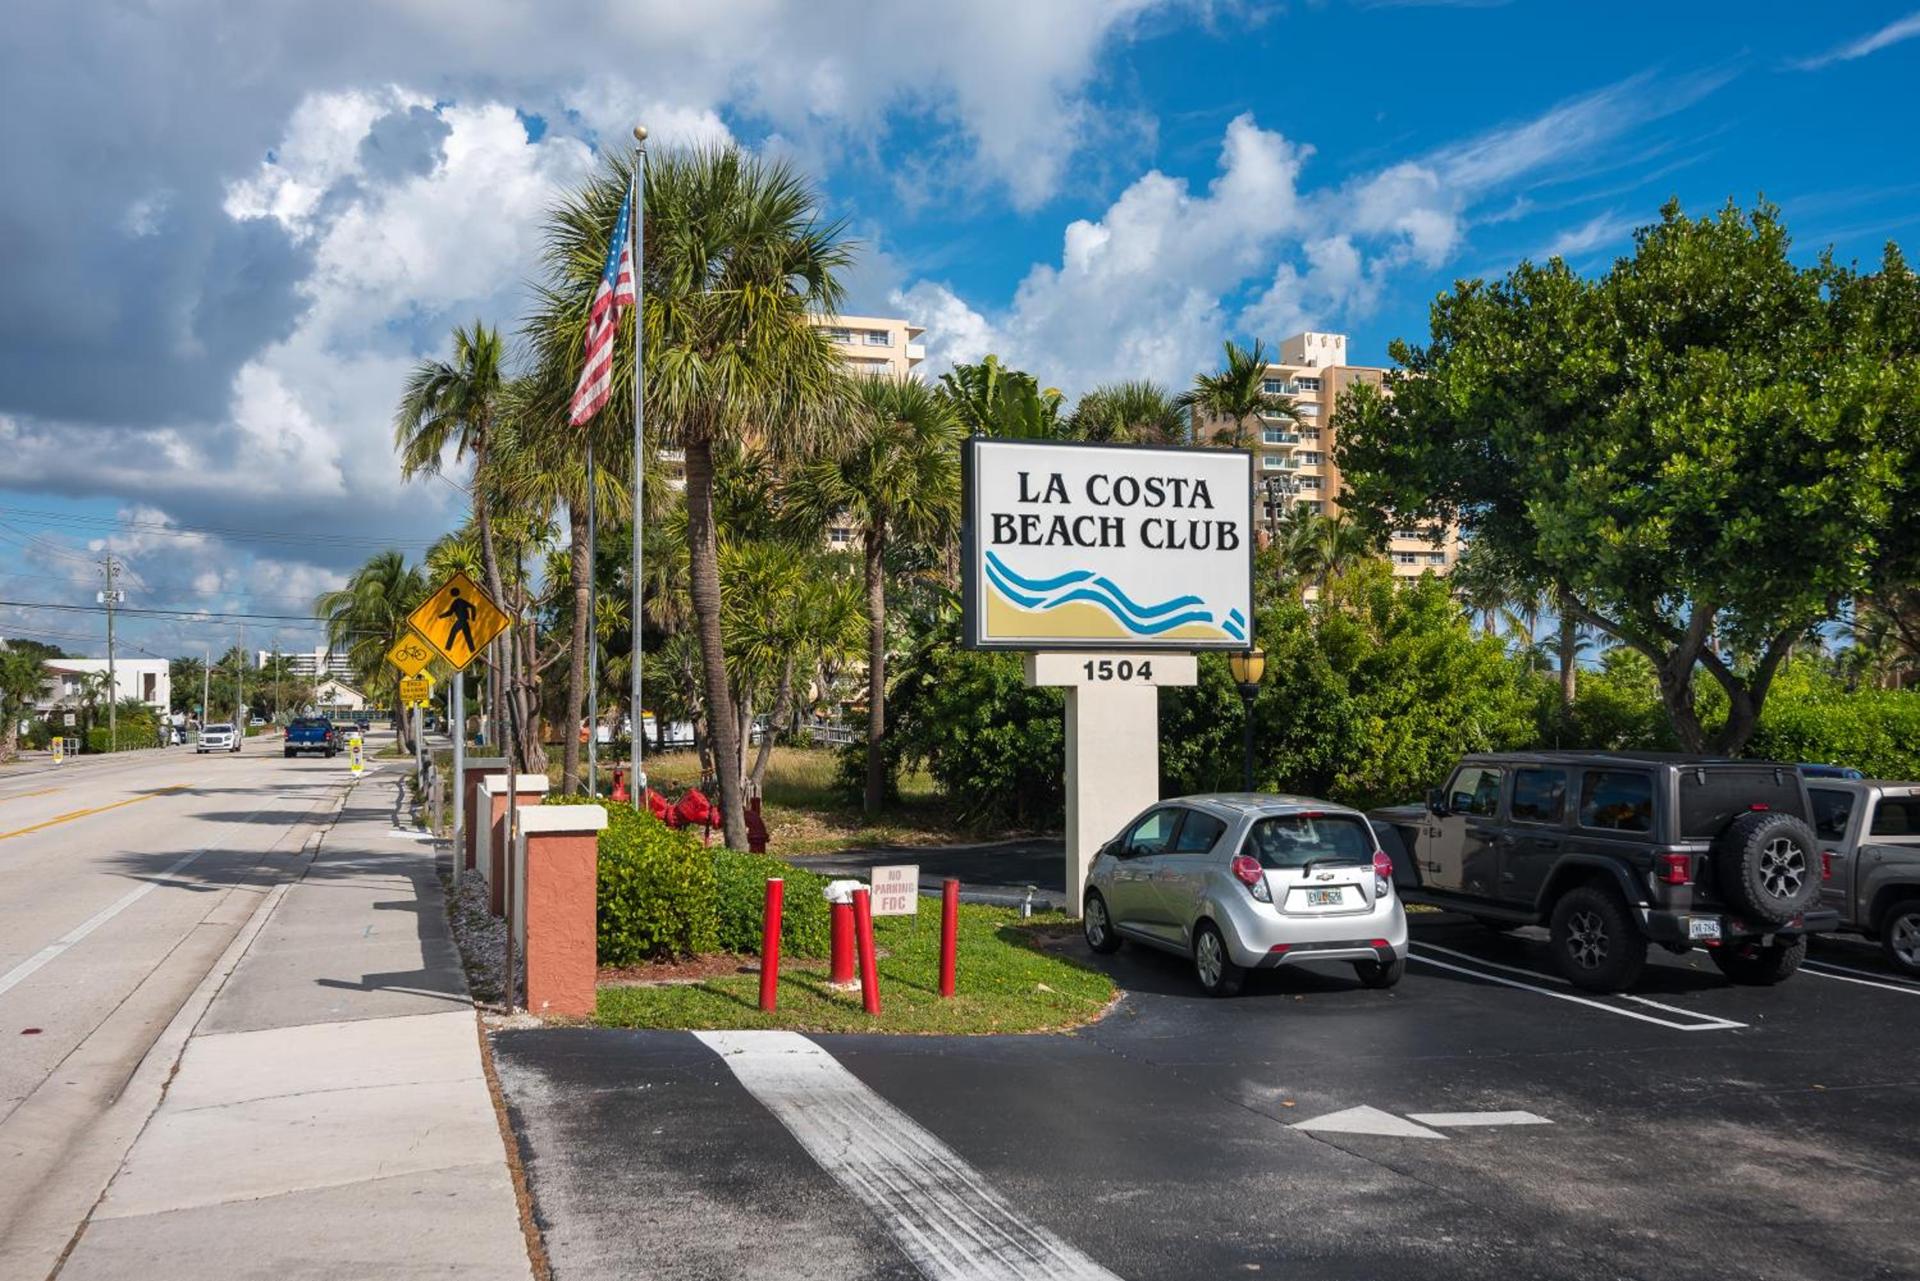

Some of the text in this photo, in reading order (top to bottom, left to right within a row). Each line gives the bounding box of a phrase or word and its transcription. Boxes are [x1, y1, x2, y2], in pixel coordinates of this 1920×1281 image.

[1017, 471, 1214, 509] LA COSTA
[992, 513, 1240, 551] BEACH CLUB
[1083, 660, 1153, 681] 1504
[888, 870, 902, 880] NO
[875, 882, 914, 894] PARKING
[881, 896, 906, 910] FDC
